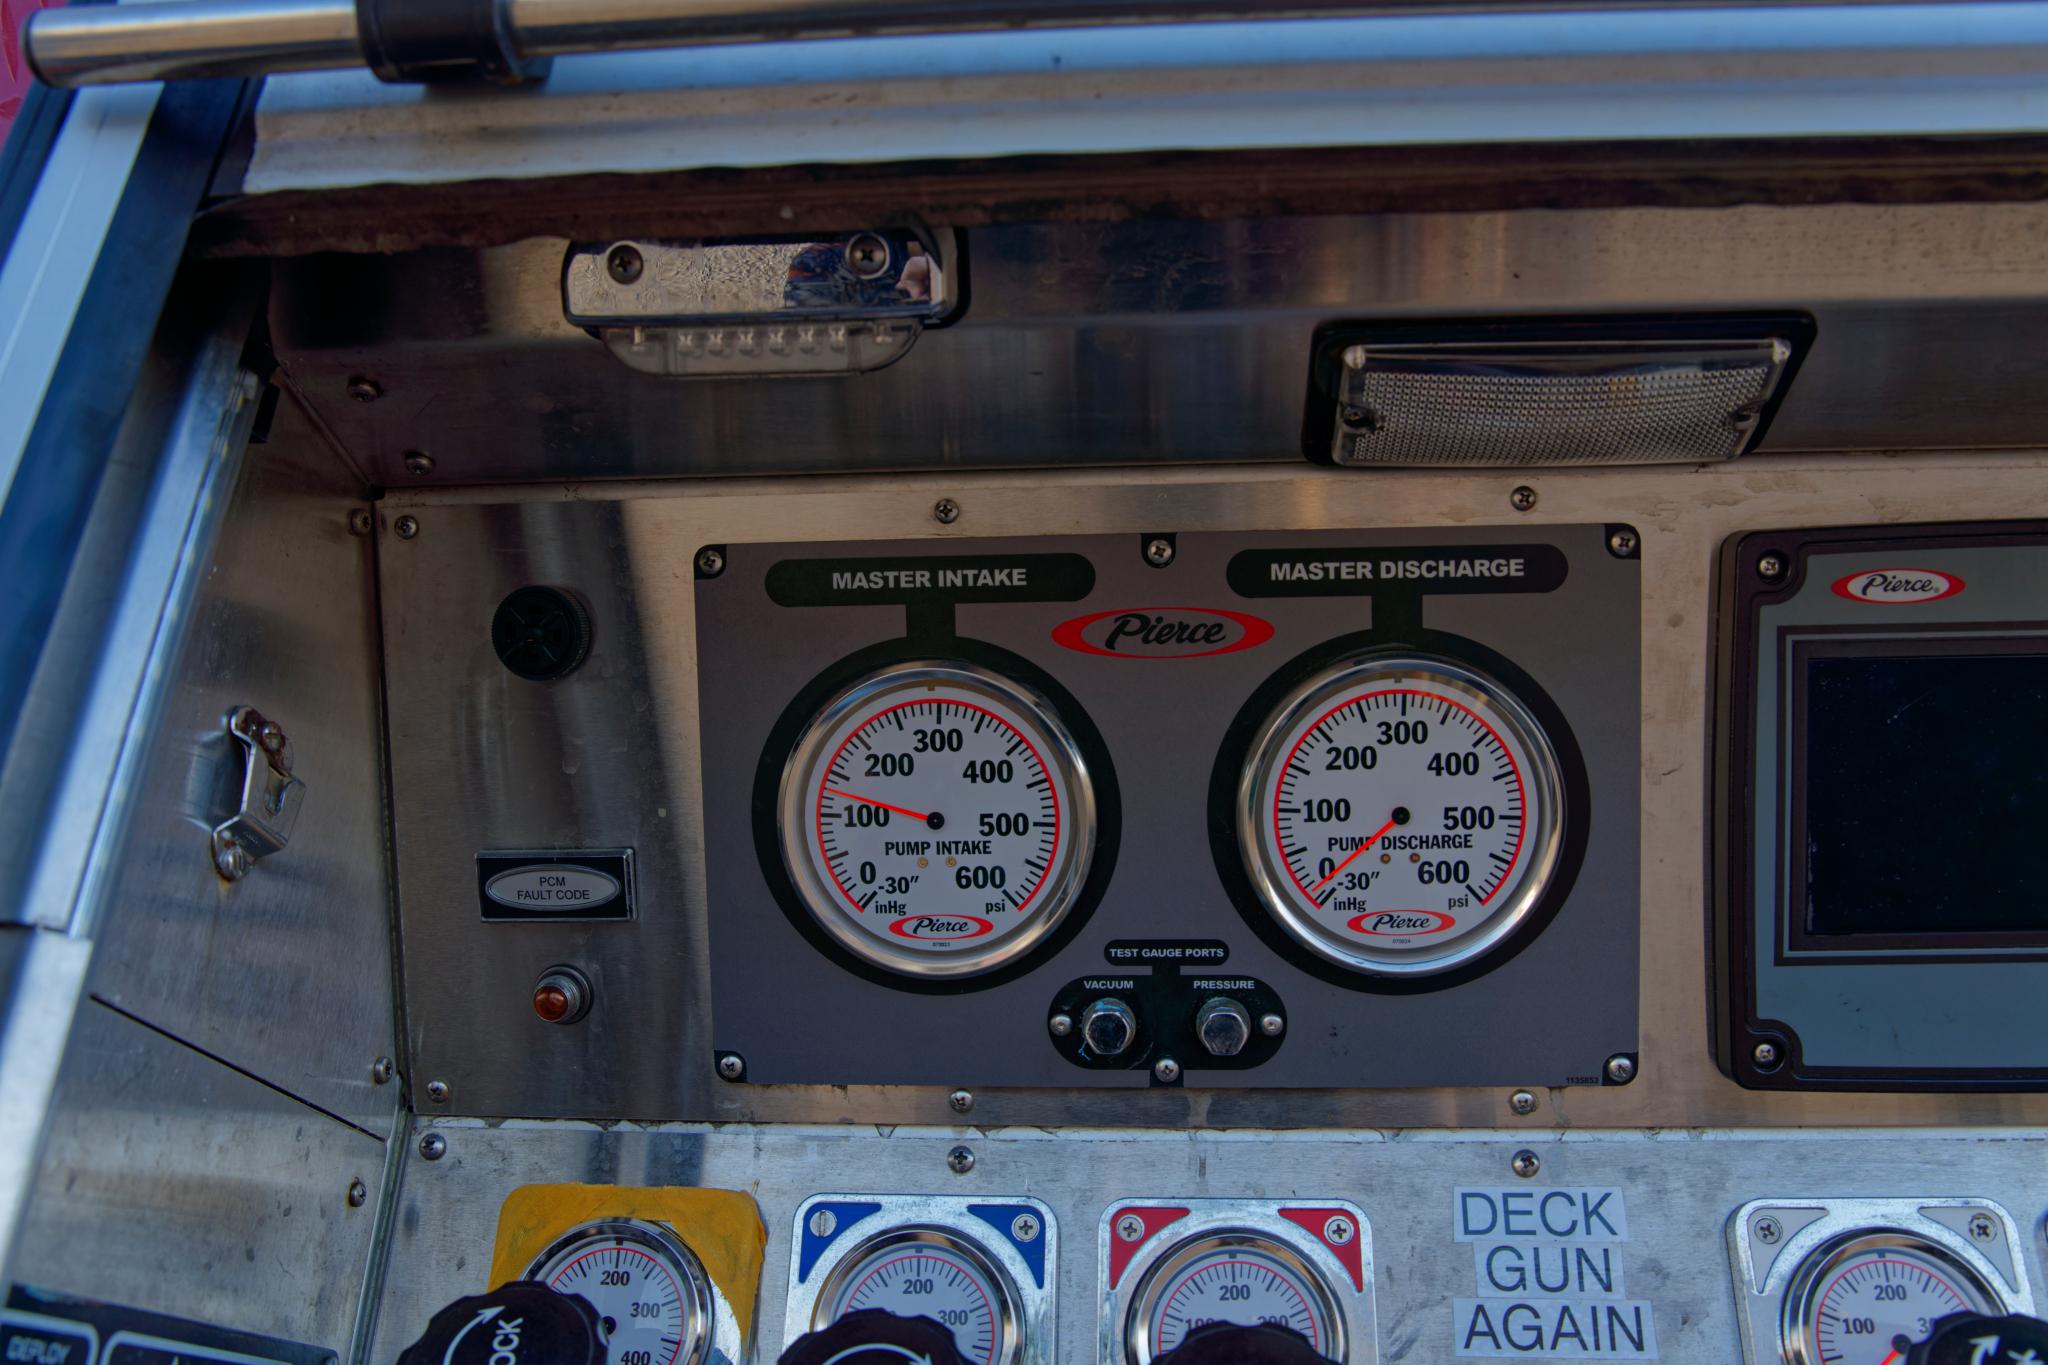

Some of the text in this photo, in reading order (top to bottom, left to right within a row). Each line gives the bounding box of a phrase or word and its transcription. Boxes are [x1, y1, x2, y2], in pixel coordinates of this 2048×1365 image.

[832, 568, 1027, 590] MASTER INTAKE
[1270, 558, 1525, 581] MASTER DISCHARGE
[1105, 612, 1227, 650] Pierce
[912, 728, 963, 752] 300
[1376, 720, 1428, 745] 300
[864, 753, 914, 777] 200
[1325, 746, 1377, 771] 200
[1427, 751, 1479, 777] 400
[962, 759, 1013, 783] 400
[844, 804, 890, 827] 100
[1303, 798, 1350, 823] 100
[1443, 805, 1494, 830] 500
[978, 812, 1029, 836] 500
[885, 841, 992, 856] PUMP INTAKE
[1381, 834, 1473, 850] DISCHARGE
[860, 861, 876, 885] 0
[955, 866, 1006, 889] 600
[1318, 857, 1335, 880] 0
[1417, 860, 1470, 885] 600
[539, 877, 566, 887] PCM
[517, 890, 590, 900] FAULT CODE
[1333, 897, 1366, 912] inHg
[1448, 895, 1468, 910] psi
[875, 900, 907, 916] inHg
[985, 899, 1005, 914] psi
[913, 917, 969, 934] Pierce
[1372, 914, 1431, 931] Pierce
[1110, 949, 1224, 957] TEST GAUGE PORTS
[1084, 981, 1133, 989] VACUUM
[1193, 980, 1255, 989] PRESSURE
[1461, 1191, 1618, 1237] DECK
[600, 1270, 630, 1286] 200
[1486, 1245, 1613, 1293] GUN
[903, 1278, 933, 1295] 200
[1219, 1285, 1250, 1301] 200
[1874, 1284, 1907, 1301] 200
[630, 1302, 660, 1319] 300
[938, 1309, 968, 1326] 300
[1464, 1303, 1645, 1352] AGAIN
[1842, 1318, 1875, 1334] 100
[488, 1317, 524, 1365] OCK
[620, 1351, 650, 1365] 400
